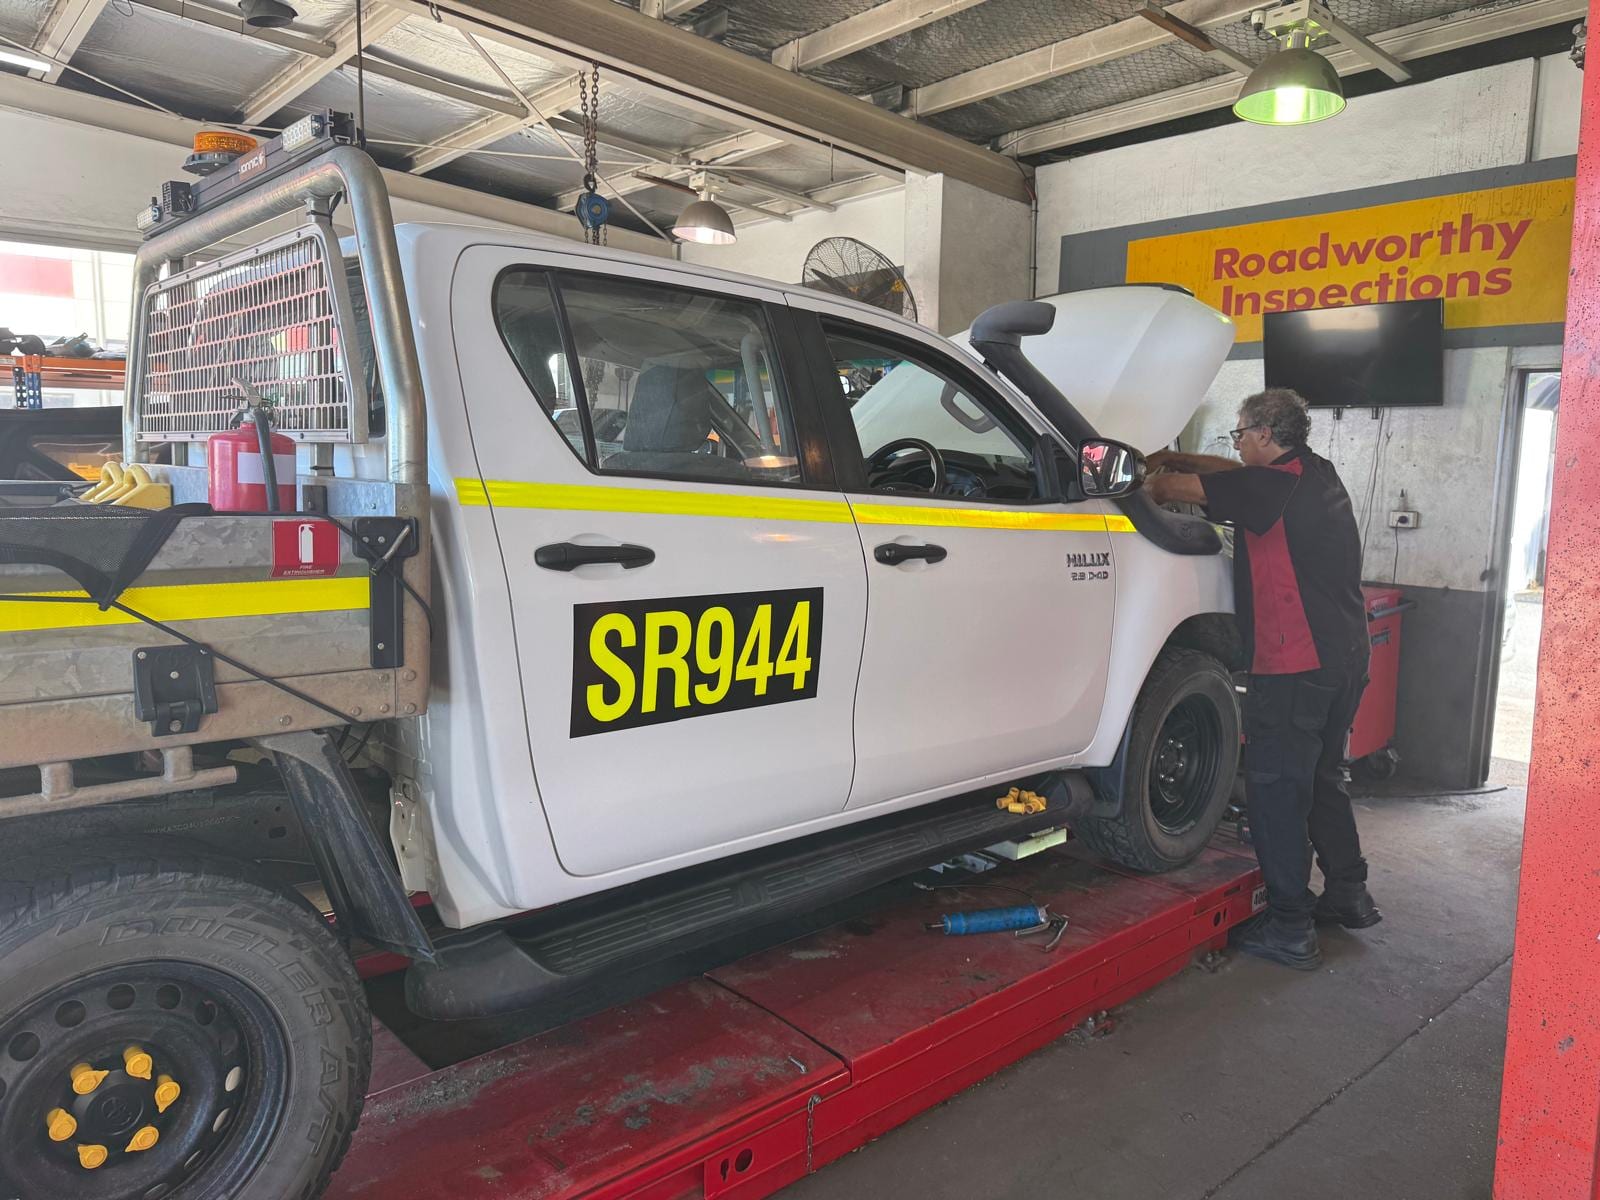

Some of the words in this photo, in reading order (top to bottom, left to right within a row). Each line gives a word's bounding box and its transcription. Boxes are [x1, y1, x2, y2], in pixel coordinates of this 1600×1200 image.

[1213, 213, 1533, 280] Roadworthy
[1221, 267, 1513, 316] Inspections
[1066, 552, 1110, 567] HILUX
[586, 600, 812, 722] SR944
[98, 914, 333, 1028] DUELER
